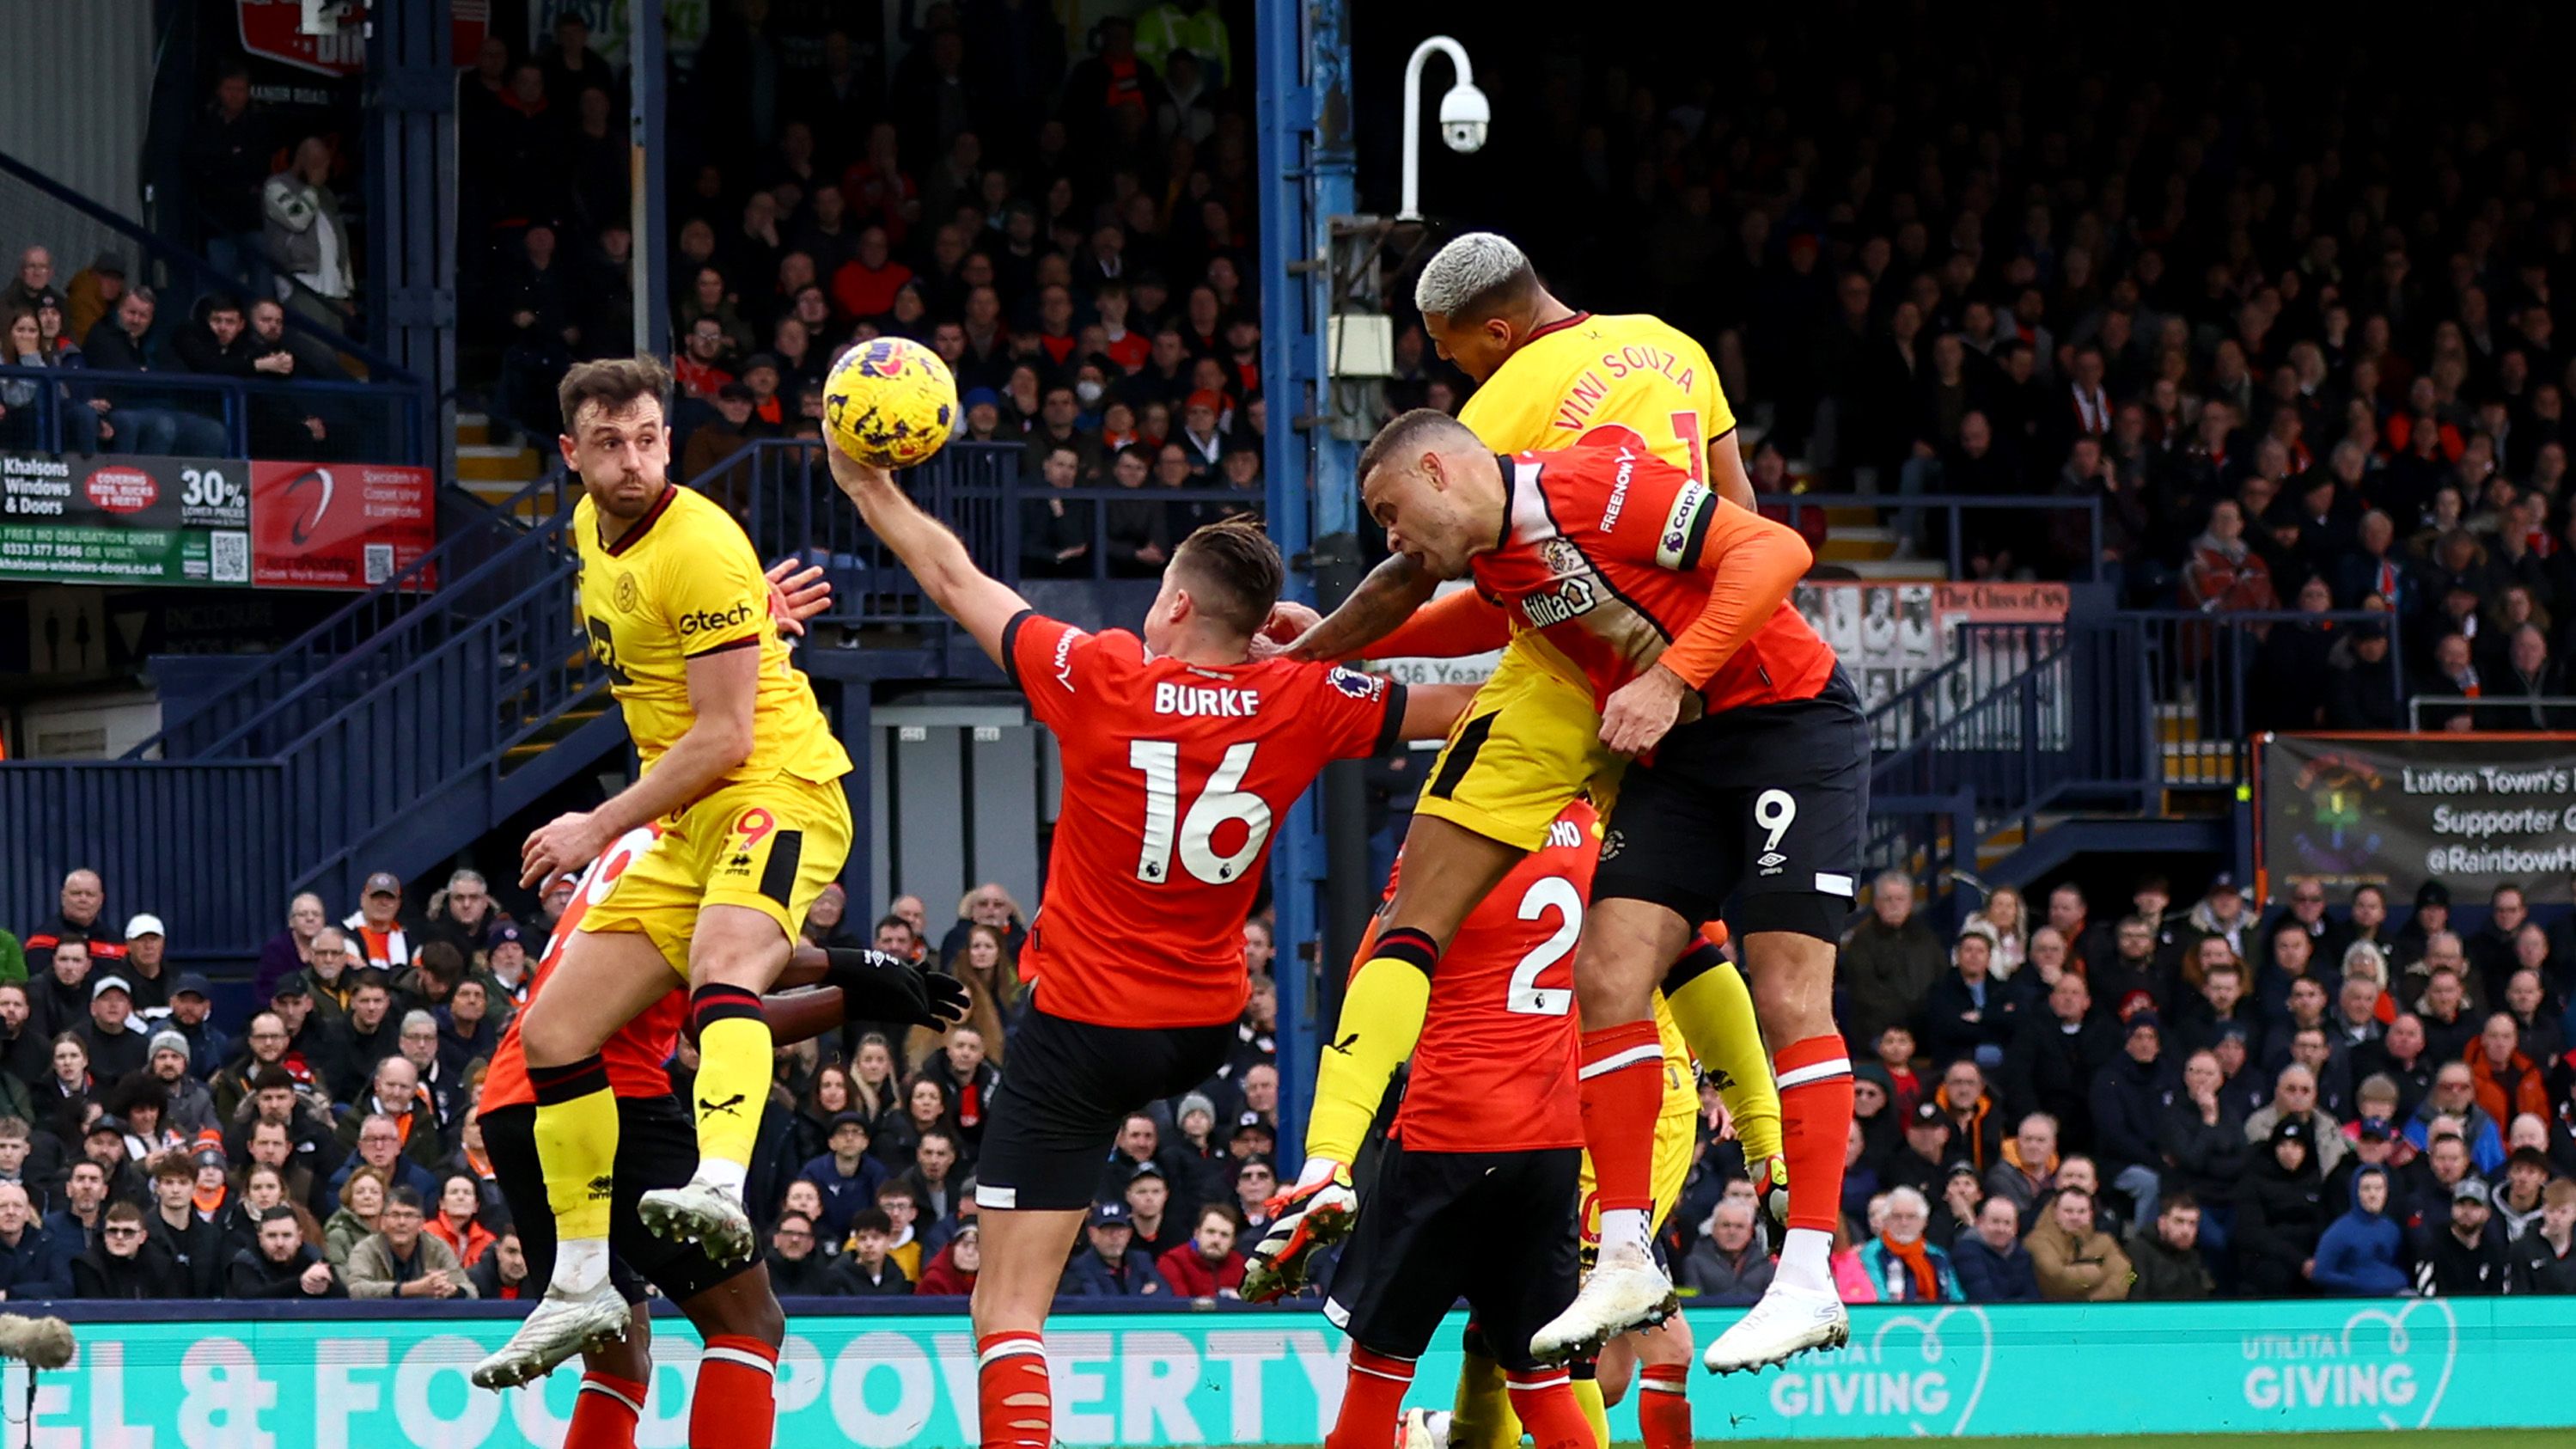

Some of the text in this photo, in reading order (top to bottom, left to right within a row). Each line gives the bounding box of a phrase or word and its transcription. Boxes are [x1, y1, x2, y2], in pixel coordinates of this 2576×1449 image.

[1554, 346, 1694, 431] VINI SOUZA
[4, 458, 69, 478] Khalsons
[4, 478, 71, 497] Windows
[1600, 462, 1634, 533] FREENOW
[5, 497, 63, 516] & Doors
[5, 528, 167, 547] FREE NO OBLIGATION QUOTE
[85, 546, 102, 559] OR
[680, 601, 754, 636] Gtech
[1435, 663, 1492, 684] Year
[1155, 682, 1259, 717] BURKE
[2402, 767, 2568, 793] Luton Town's
[737, 807, 774, 852] 9
[1130, 740, 1272, 884] 16
[1754, 788, 1797, 852] 9
[2433, 804, 2558, 838] Supporter
[1506, 876, 1584, 1015] 2
[2243, 1334, 2335, 1360] UTILITA
[177, 1336, 278, 1449] &
[1770, 1370, 1950, 1416] GIVING
[2243, 1363, 2417, 1409] GIVING
